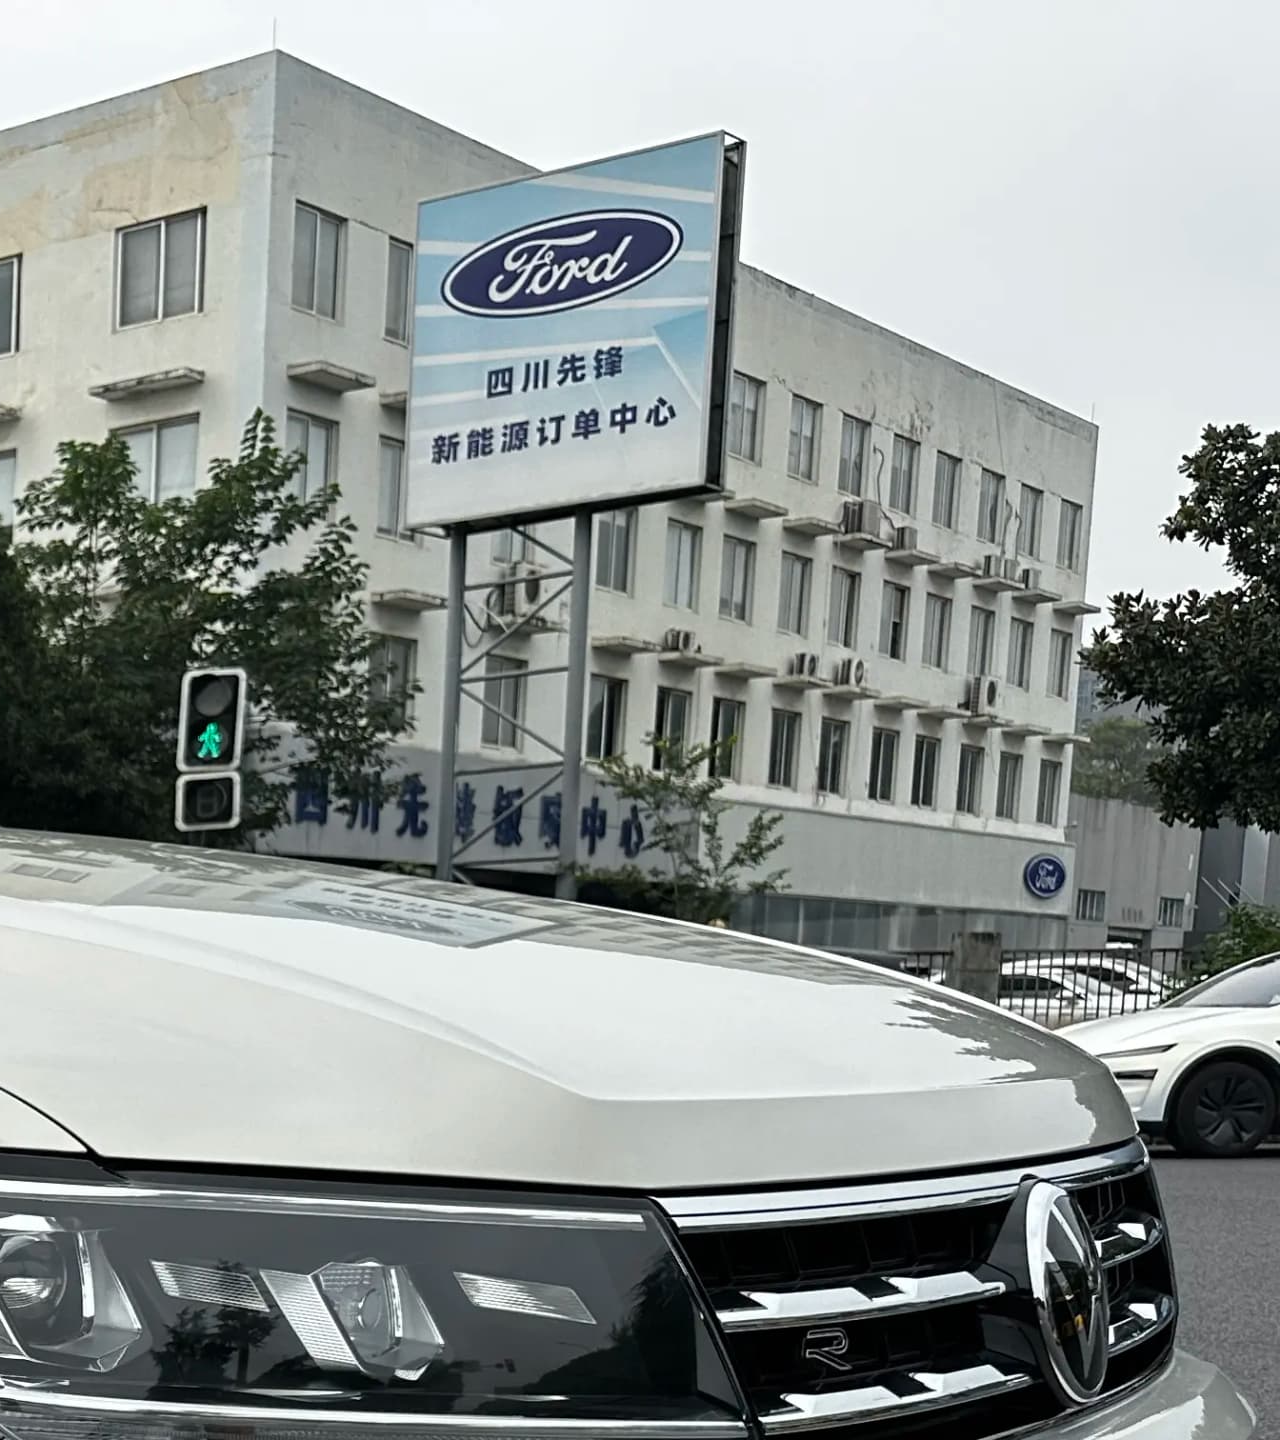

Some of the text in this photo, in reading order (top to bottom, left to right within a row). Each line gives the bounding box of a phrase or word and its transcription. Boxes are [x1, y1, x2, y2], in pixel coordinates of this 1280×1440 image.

[487, 229, 633, 303] Ford
[486, 346, 624, 399] 四川先锋
[430, 396, 677, 465] 新能源订单中心
[805, 1326, 853, 1371] R
